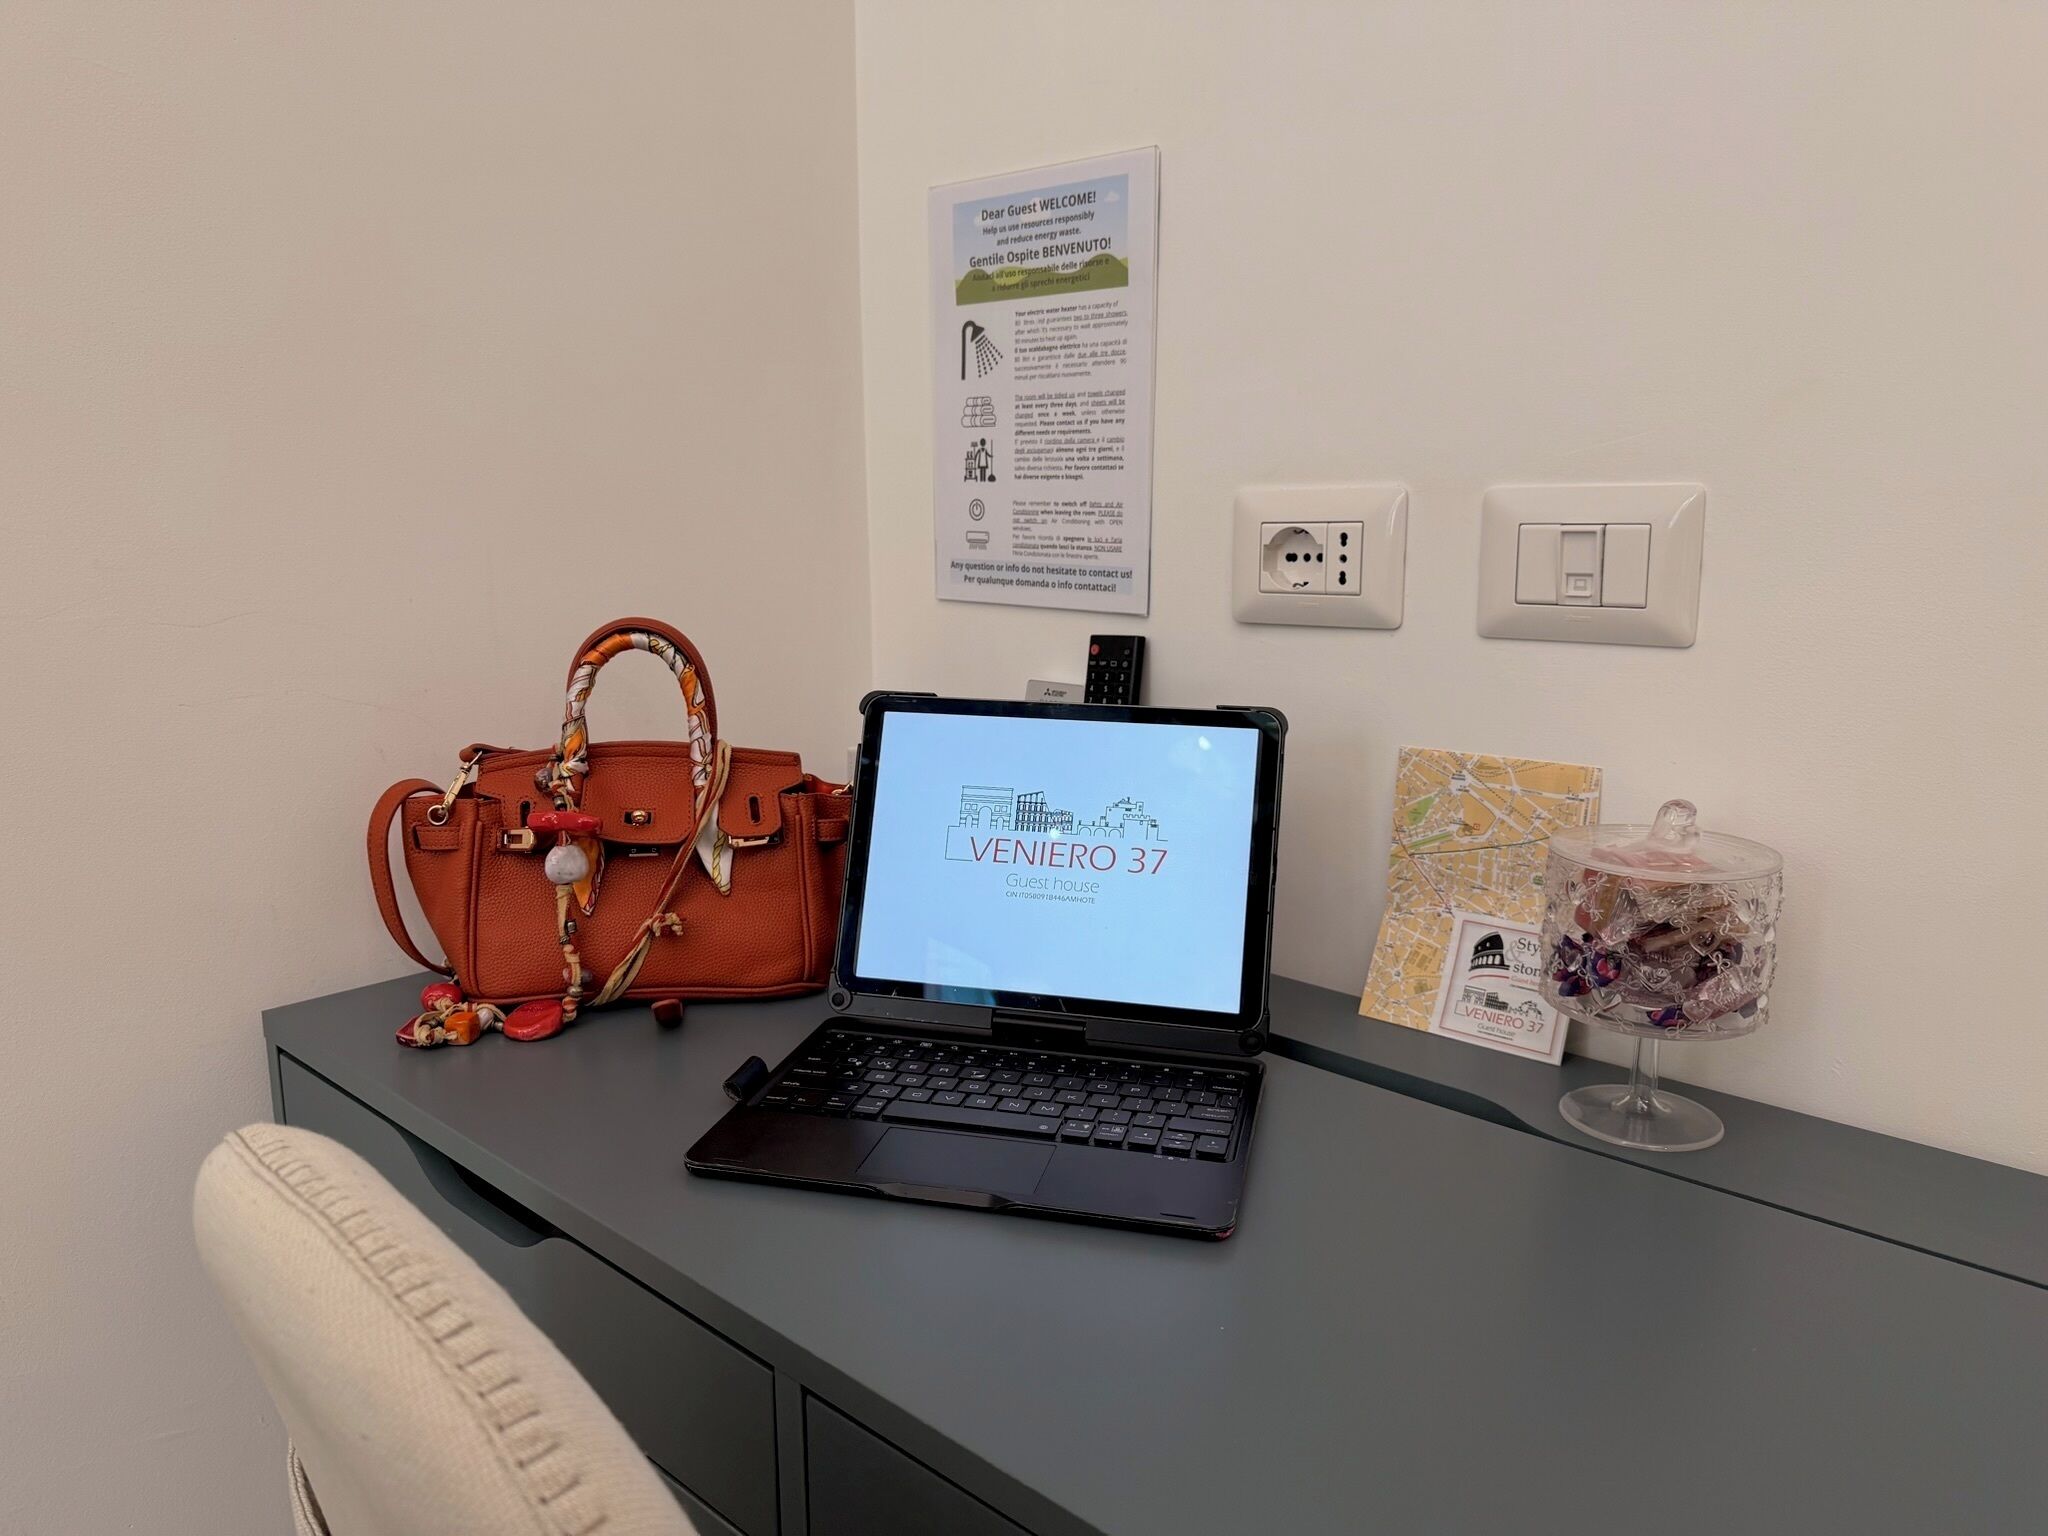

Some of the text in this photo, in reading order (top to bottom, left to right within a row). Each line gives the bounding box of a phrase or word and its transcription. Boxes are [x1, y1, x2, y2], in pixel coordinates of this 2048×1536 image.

[982, 193, 1096, 221] Dear Guest WELCOME!
[983, 225, 998, 237] Help
[1021, 219, 1053, 229] resources
[1055, 211, 1094, 227] responsibly
[997, 226, 1081, 246] and reduce energy waste.
[970, 239, 1111, 268] Gentile Ospite BENVENUTO!
[1018, 263, 1059, 278] responsabile
[1061, 261, 1077, 271] delle
[1079, 258, 1103, 269] risorse
[1031, 277, 1054, 289] sprechi
[1056, 273, 1090, 287] energetici
[951, 561, 963, 571] Any
[965, 561, 995, 572] question
[1006, 564, 1019, 572] info
[1021, 564, 1030, 573] do
[1032, 565, 1044, 573] not
[1046, 566, 1077, 575] hesitate
[1079, 568, 1087, 576] to
[1089, 568, 1119, 578] contact
[1121, 570, 1132, 579] us!
[964, 574, 975, 582] Per
[977, 575, 1013, 587] qualunque
[1016, 577, 1049, 587] domanda
[1058, 580, 1073, 589] info
[1074, 581, 1116, 592] contattaci!
[970, 836, 1168, 875] VENIERO 37
[1006, 873, 1100, 894] Guest house
[1465, 1005, 1544, 1034] VENIERO 37
